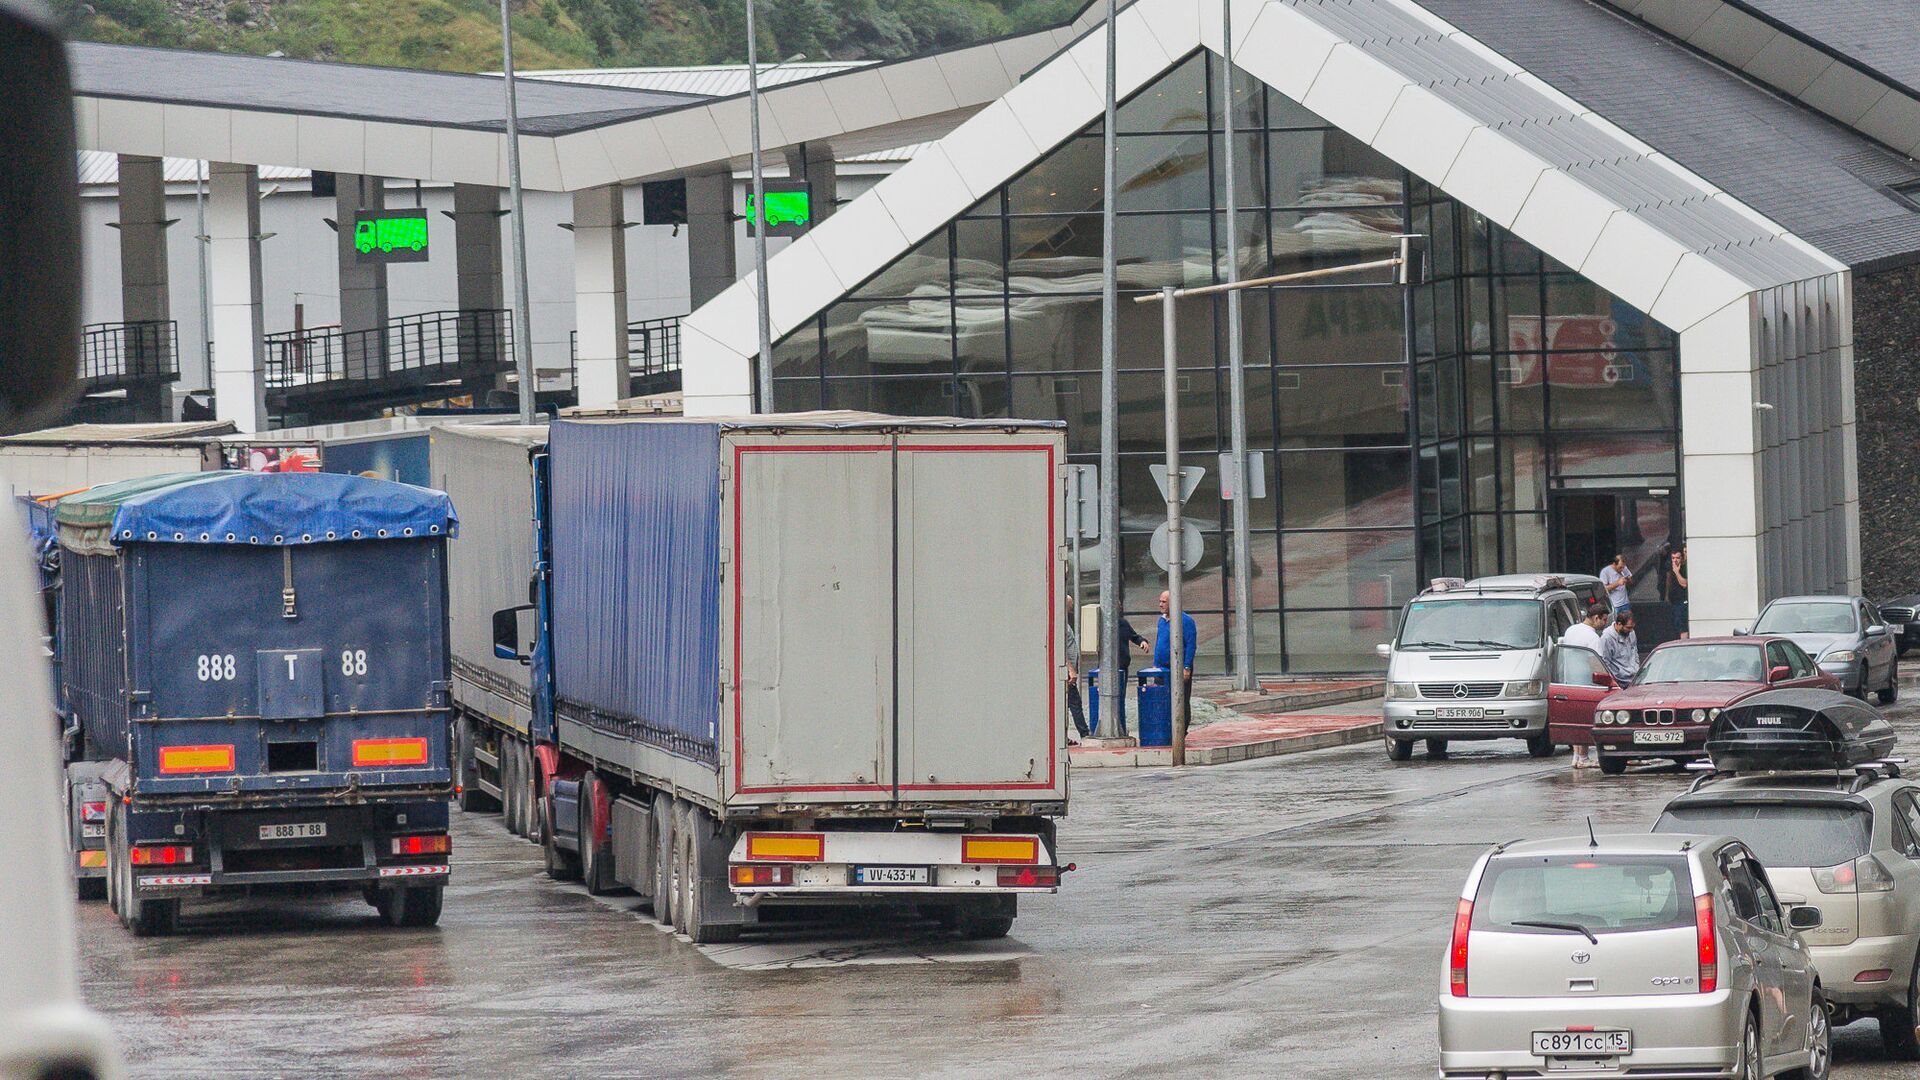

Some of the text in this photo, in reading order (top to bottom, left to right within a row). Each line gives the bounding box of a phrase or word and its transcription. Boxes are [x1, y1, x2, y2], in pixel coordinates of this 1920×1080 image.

[197, 650, 368, 681] 888 T 88
[1446, 709, 1455, 717] 35
[1456, 709, 1466, 717] FR
[1468, 709, 1481, 717] 906
[1756, 716, 1782, 725] THULE
[1642, 732, 1680, 742] 42 SL 972
[275, 825, 295, 838] 888
[298, 824, 305, 836] T
[308, 823, 322, 836] 88
[1540, 1033, 1623, 1050] C891CC 15
